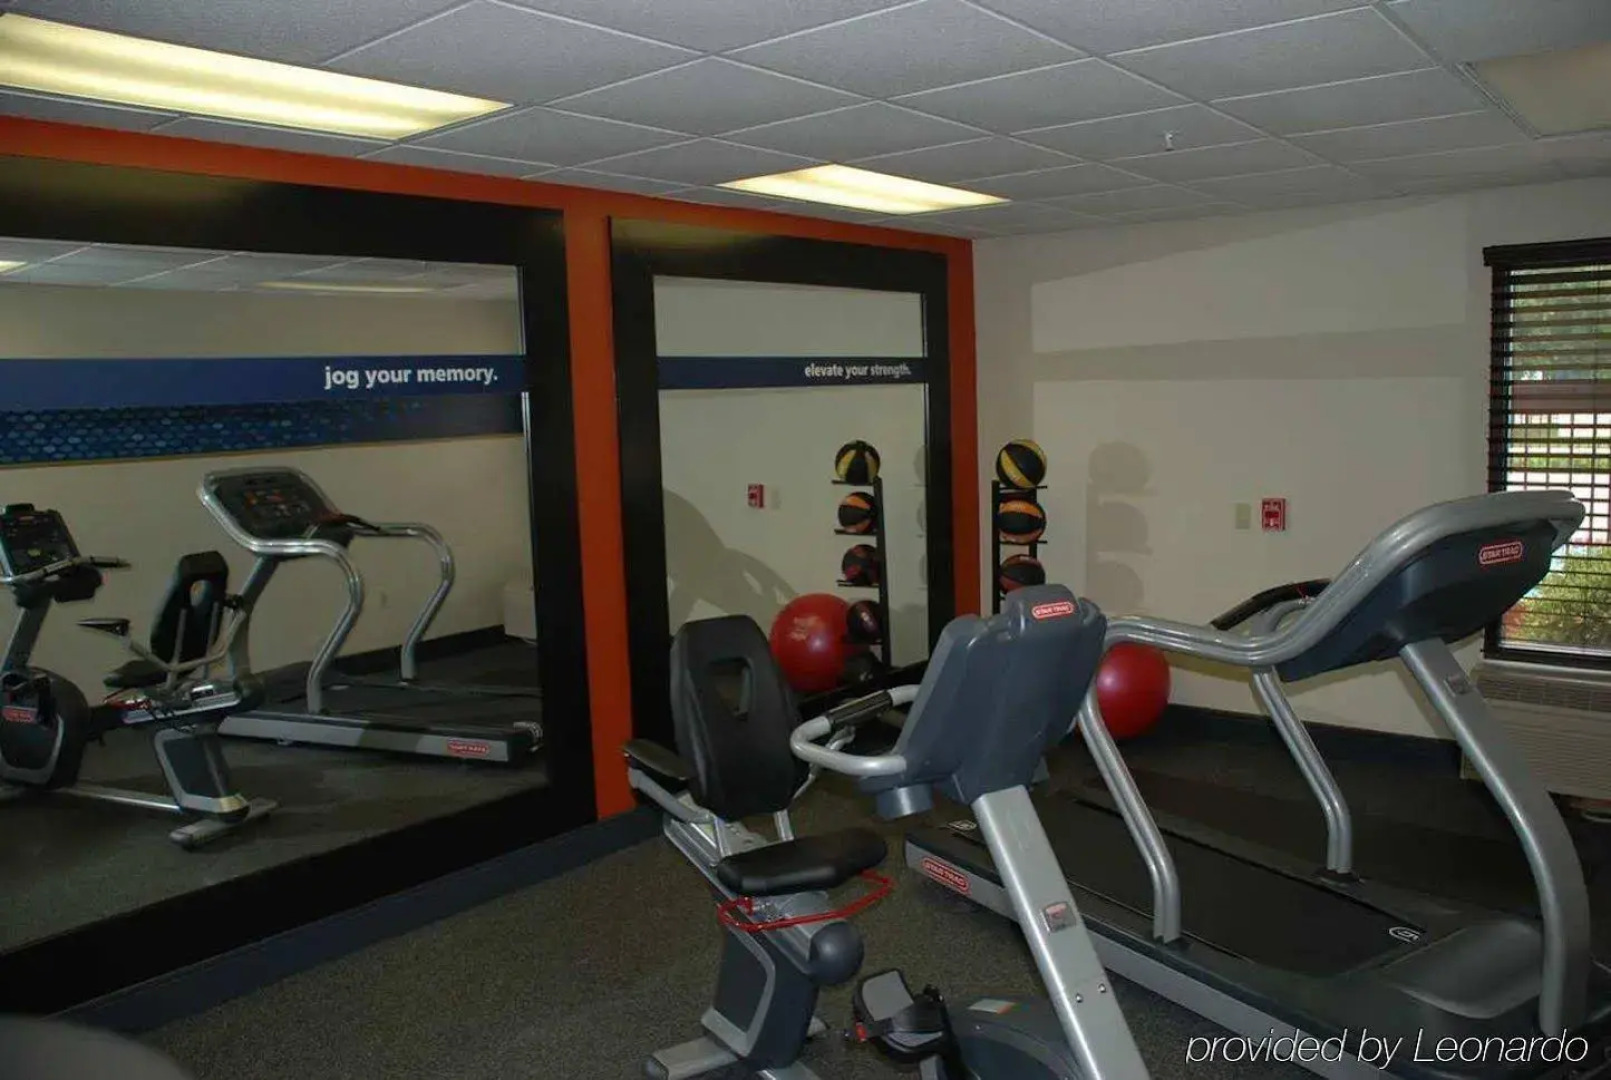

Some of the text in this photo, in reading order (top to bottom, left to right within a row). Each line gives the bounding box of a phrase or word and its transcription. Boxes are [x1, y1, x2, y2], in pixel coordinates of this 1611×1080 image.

[324, 366, 498, 389] jog your memory.
[804, 363, 844, 377] elevate
[845, 366, 868, 379] your
